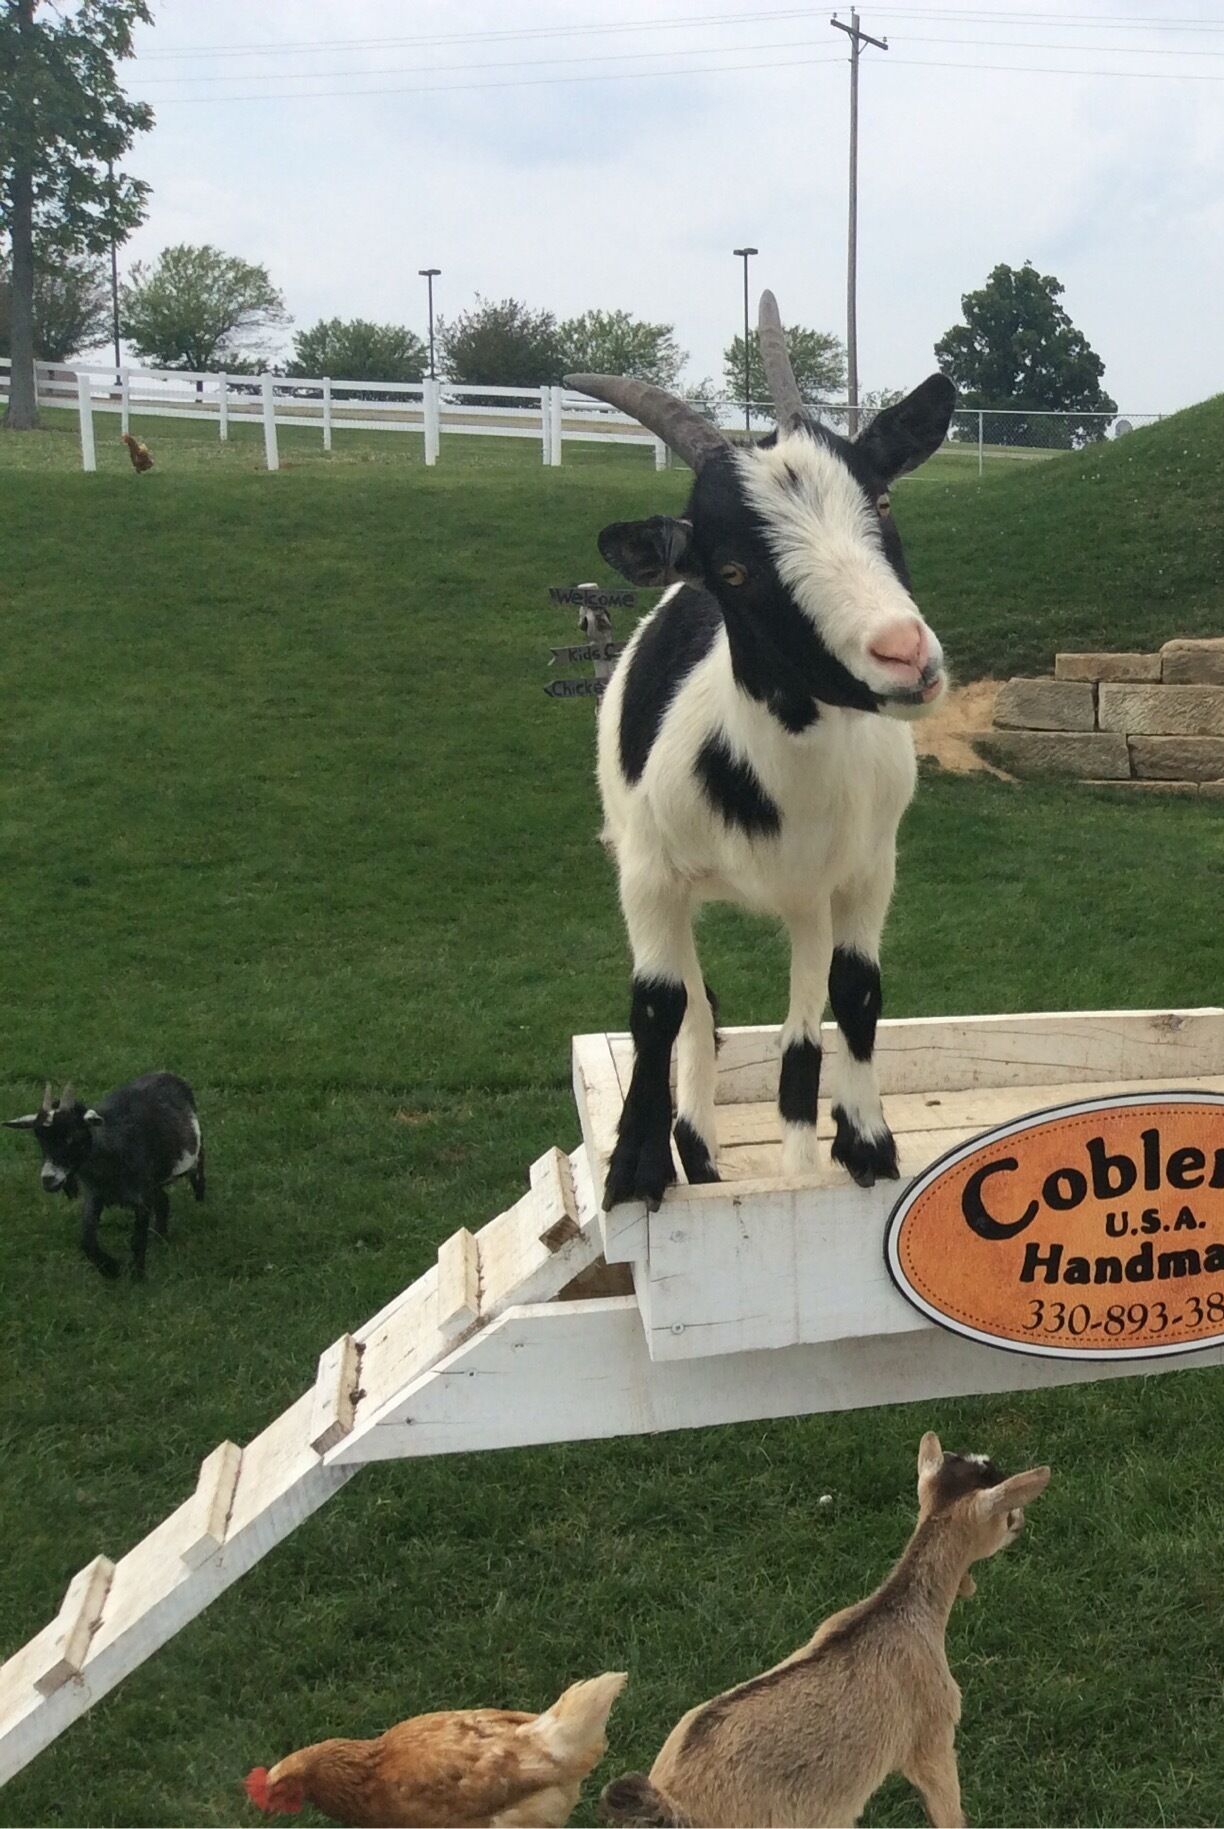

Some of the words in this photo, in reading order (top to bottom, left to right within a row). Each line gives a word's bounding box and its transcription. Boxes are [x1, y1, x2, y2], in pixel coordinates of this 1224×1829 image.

[555, 588, 635, 608] Welcome
[568, 648, 601, 662] Kids
[551, 680, 606, 696] Chicke
[1105, 1206, 1207, 1237] U.S.A.
